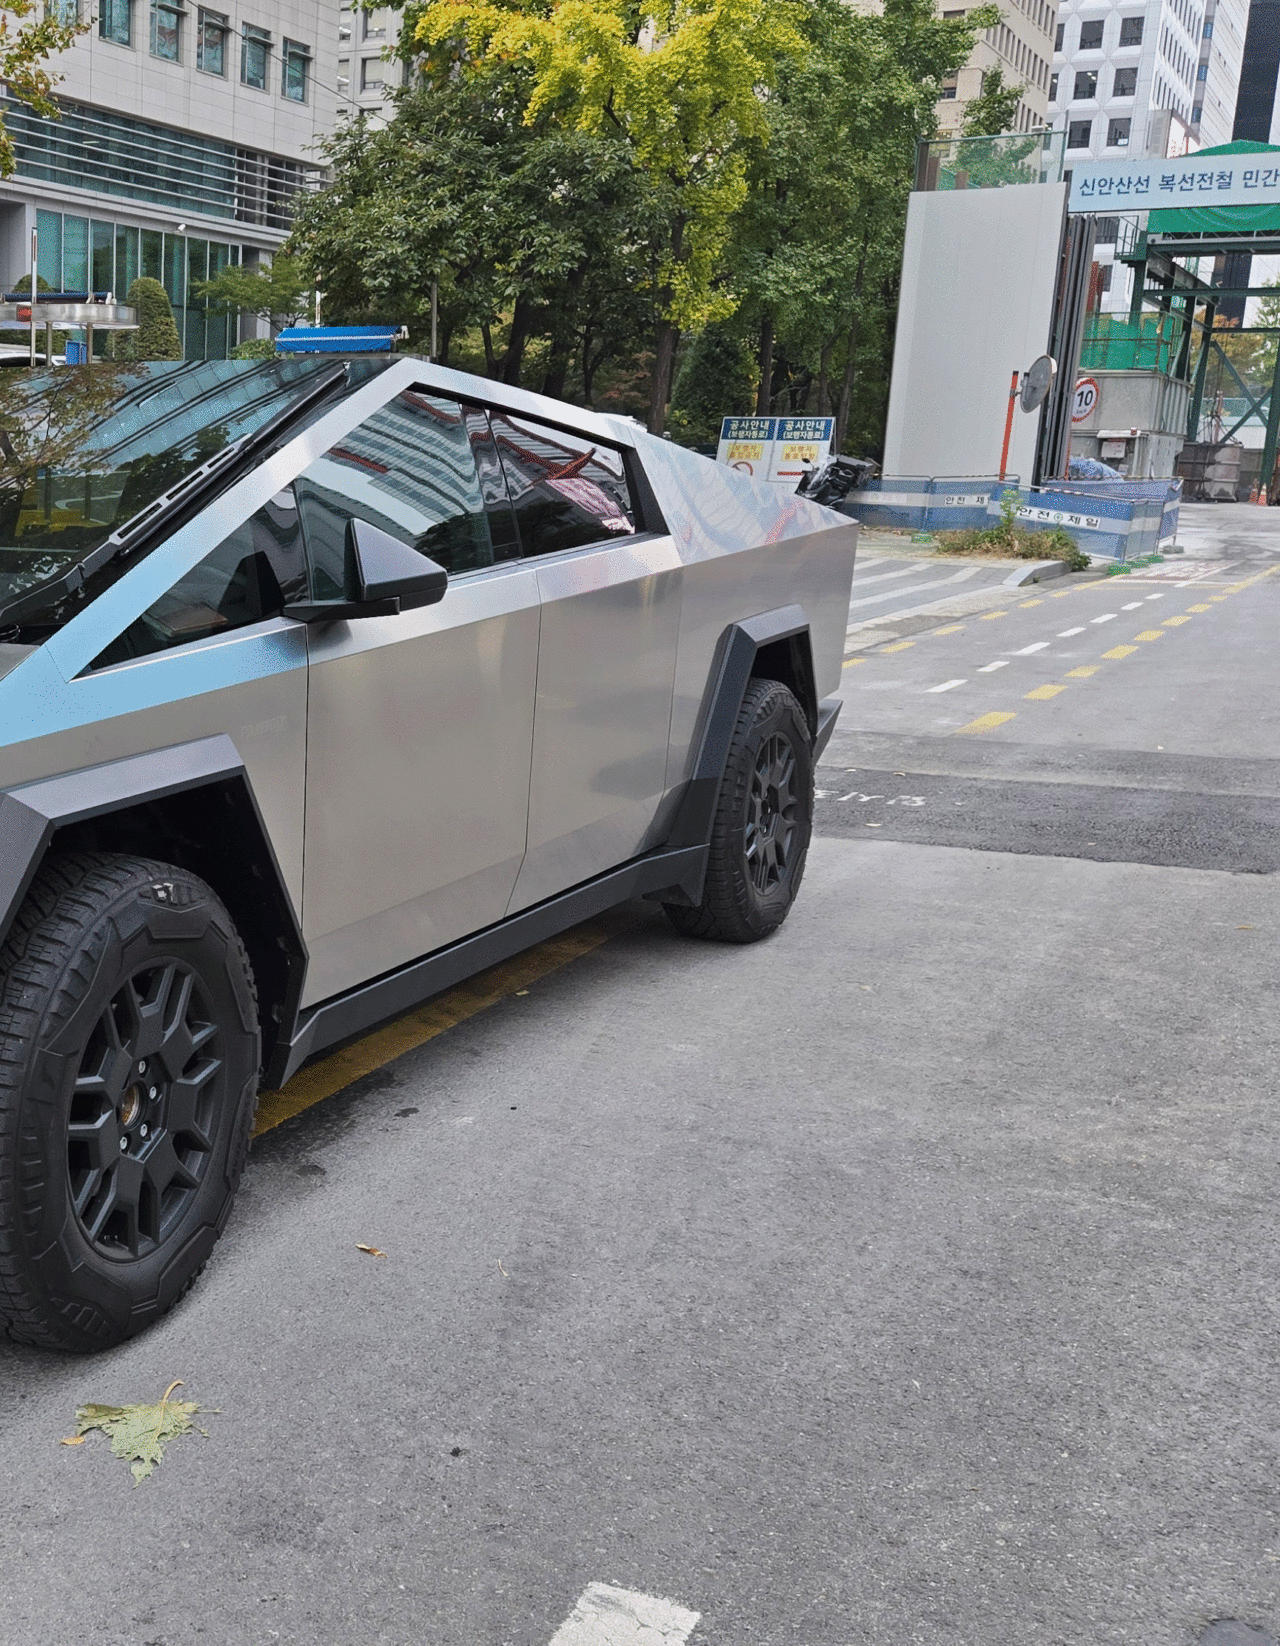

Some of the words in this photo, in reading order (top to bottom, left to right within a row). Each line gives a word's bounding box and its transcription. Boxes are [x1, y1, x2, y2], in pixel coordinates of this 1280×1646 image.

[1079, 175, 1150, 197] 신안산선
[1158, 170, 1233, 193] 복선전철
[1077, 390, 1093, 407] 10
[730, 420, 770, 430] 공사안내
[785, 420, 826, 430] 공사안내
[945, 496, 966, 505] 안전
[975, 496, 990, 505] 제
[1017, 507, 1050, 520] 안전
[1067, 515, 1099, 527] 제일
